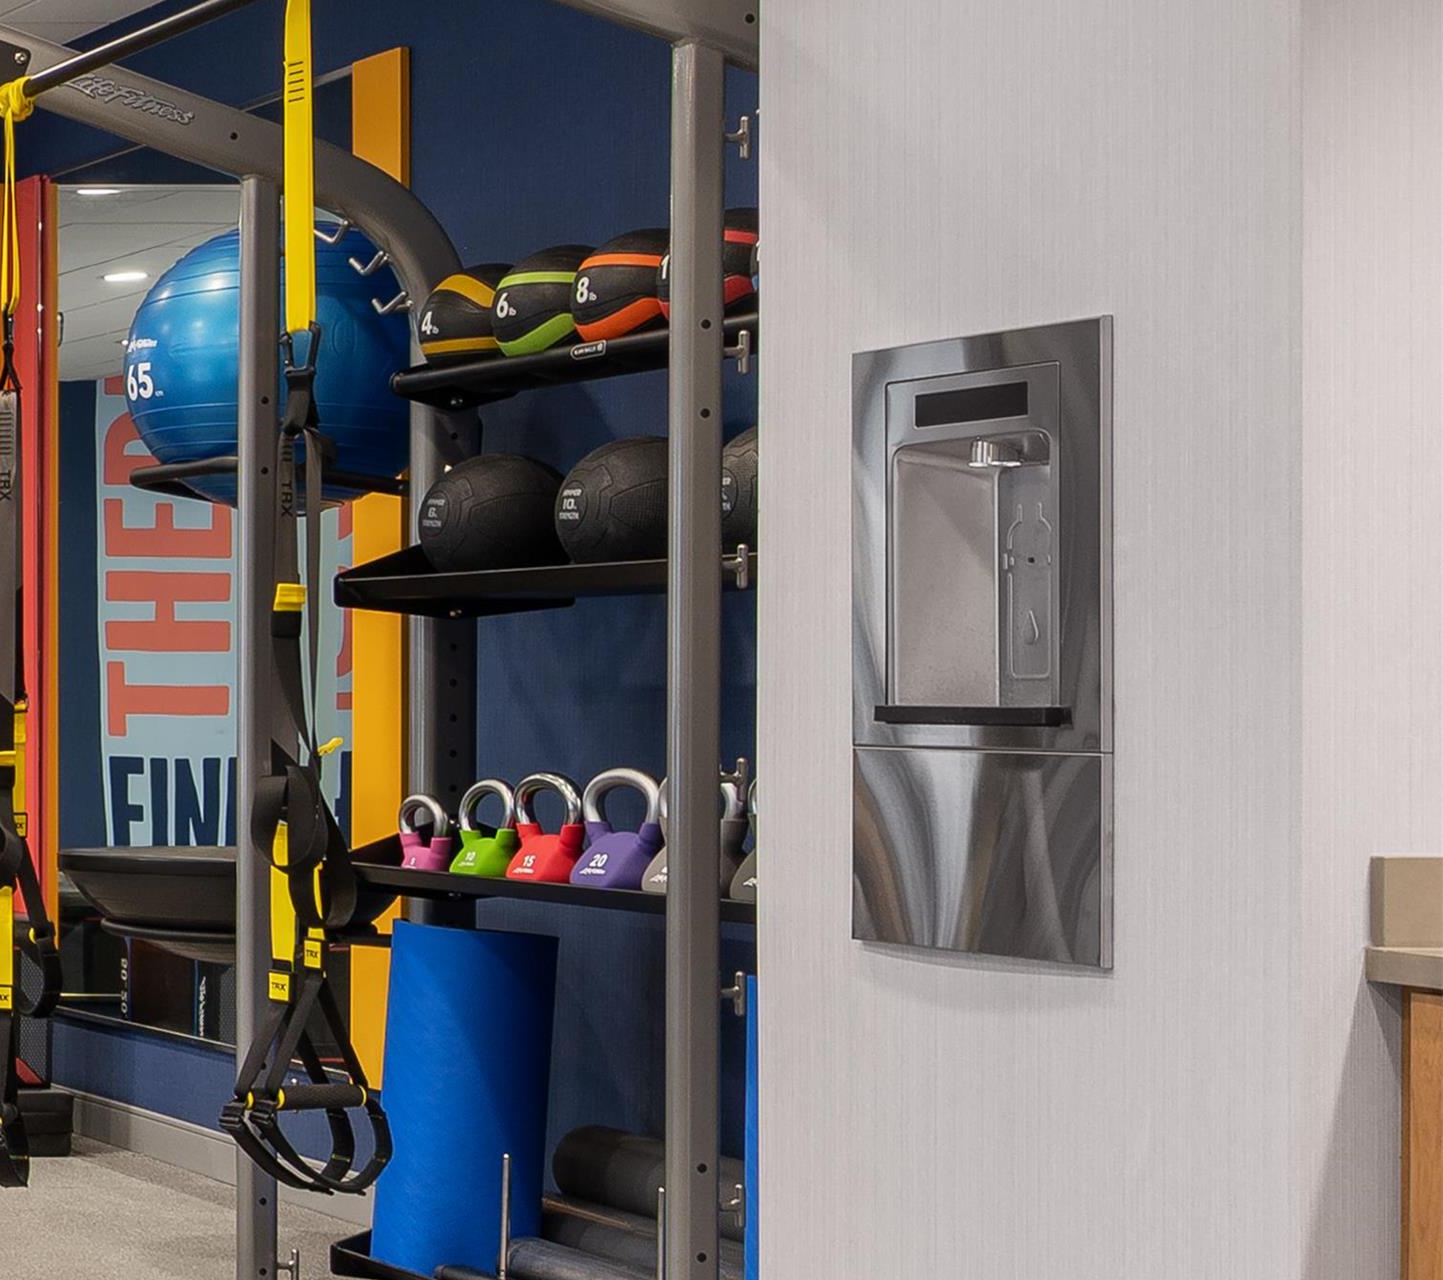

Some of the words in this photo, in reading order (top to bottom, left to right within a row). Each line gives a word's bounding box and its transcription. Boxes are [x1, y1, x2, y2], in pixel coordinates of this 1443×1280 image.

[127, 362, 154, 401] 65
[0, 470, 12, 501] TRX
[281, 481, 293, 517] TRX
[103, 410, 232, 737] THE
[109, 756, 238, 847] FIN
[523, 854, 536, 867] 15
[589, 853, 608, 868] 20
